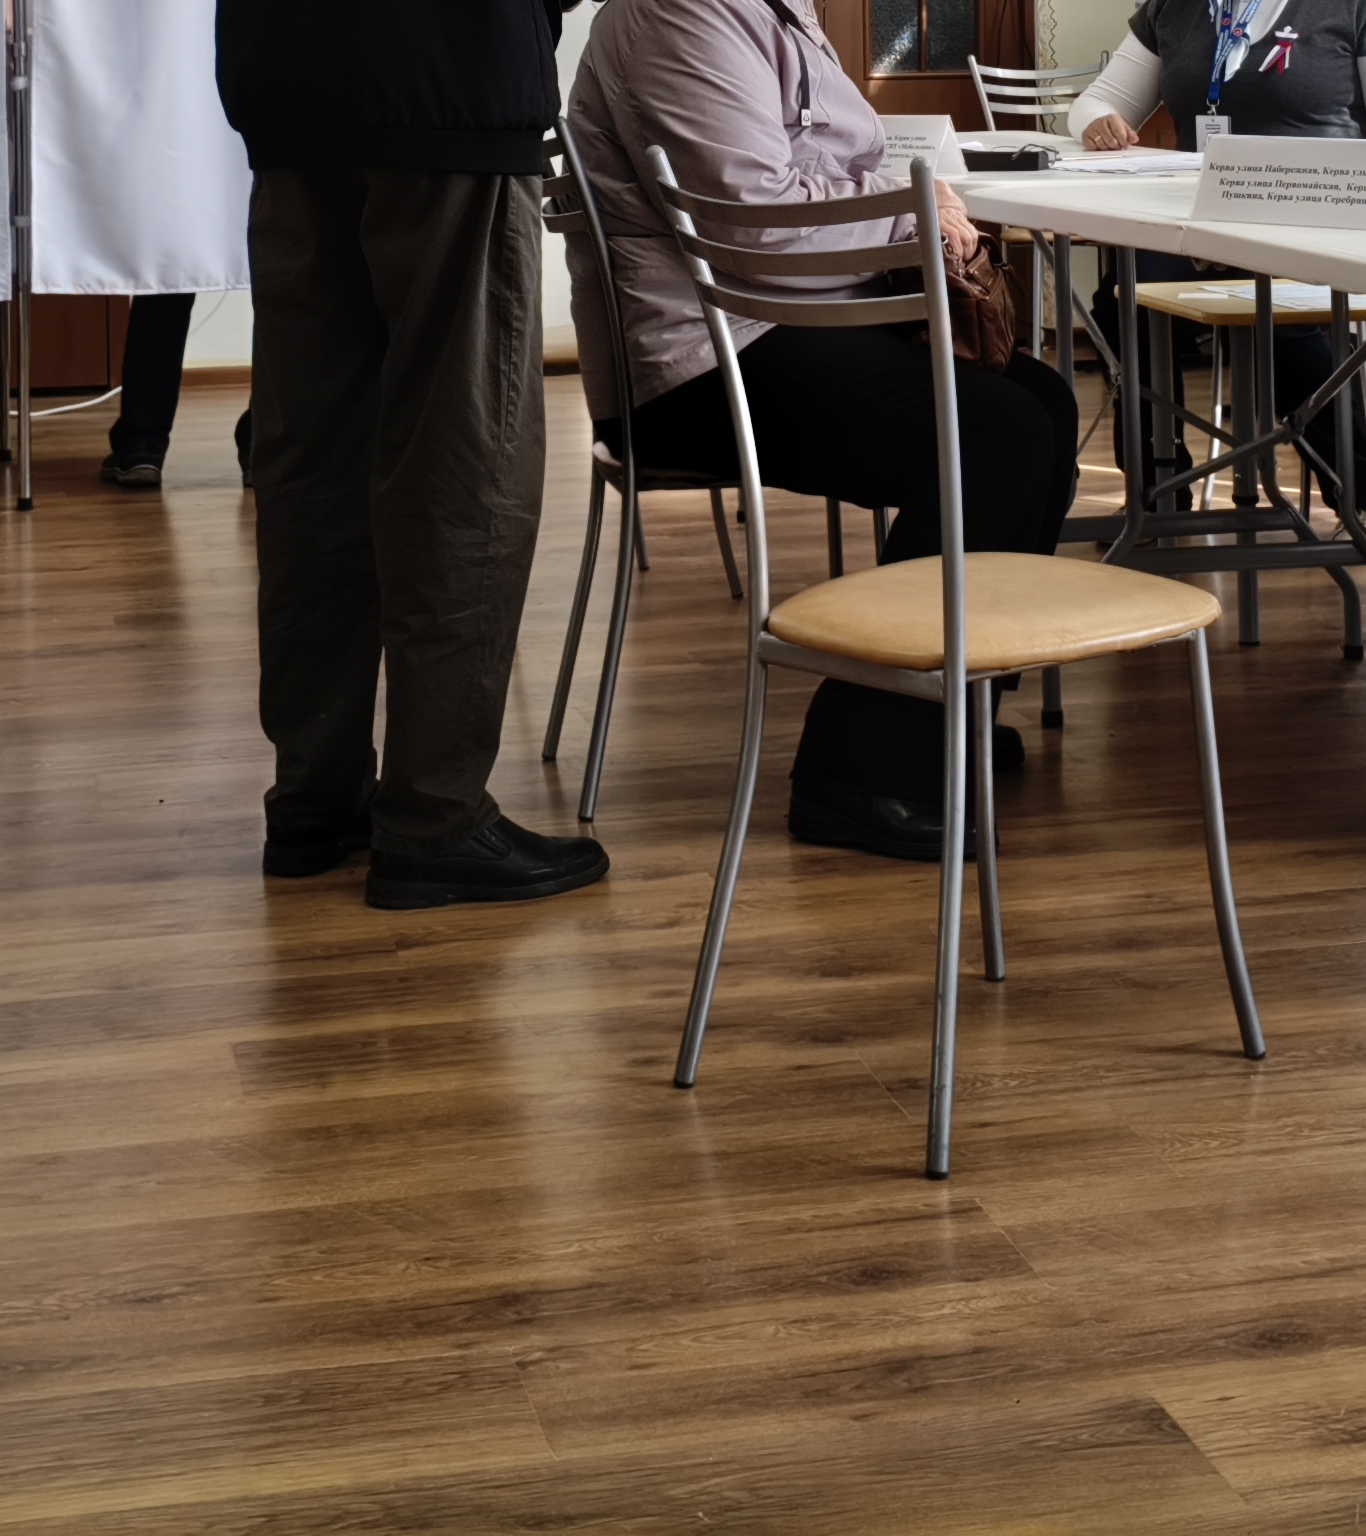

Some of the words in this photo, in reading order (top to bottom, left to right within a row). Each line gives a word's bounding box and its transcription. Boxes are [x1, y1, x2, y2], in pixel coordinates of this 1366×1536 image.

[1209, 162, 1235, 173] Керва
[1236, 165, 1263, 174] улица
[1264, 164, 1321, 175] Набережная,
[1323, 166, 1350, 177] Керва
[1219, 177, 1245, 187] Керва
[1246, 181, 1273, 189] улица
[1267, 192, 1294, 202] Керва
[1295, 195, 1322, 203] улица
